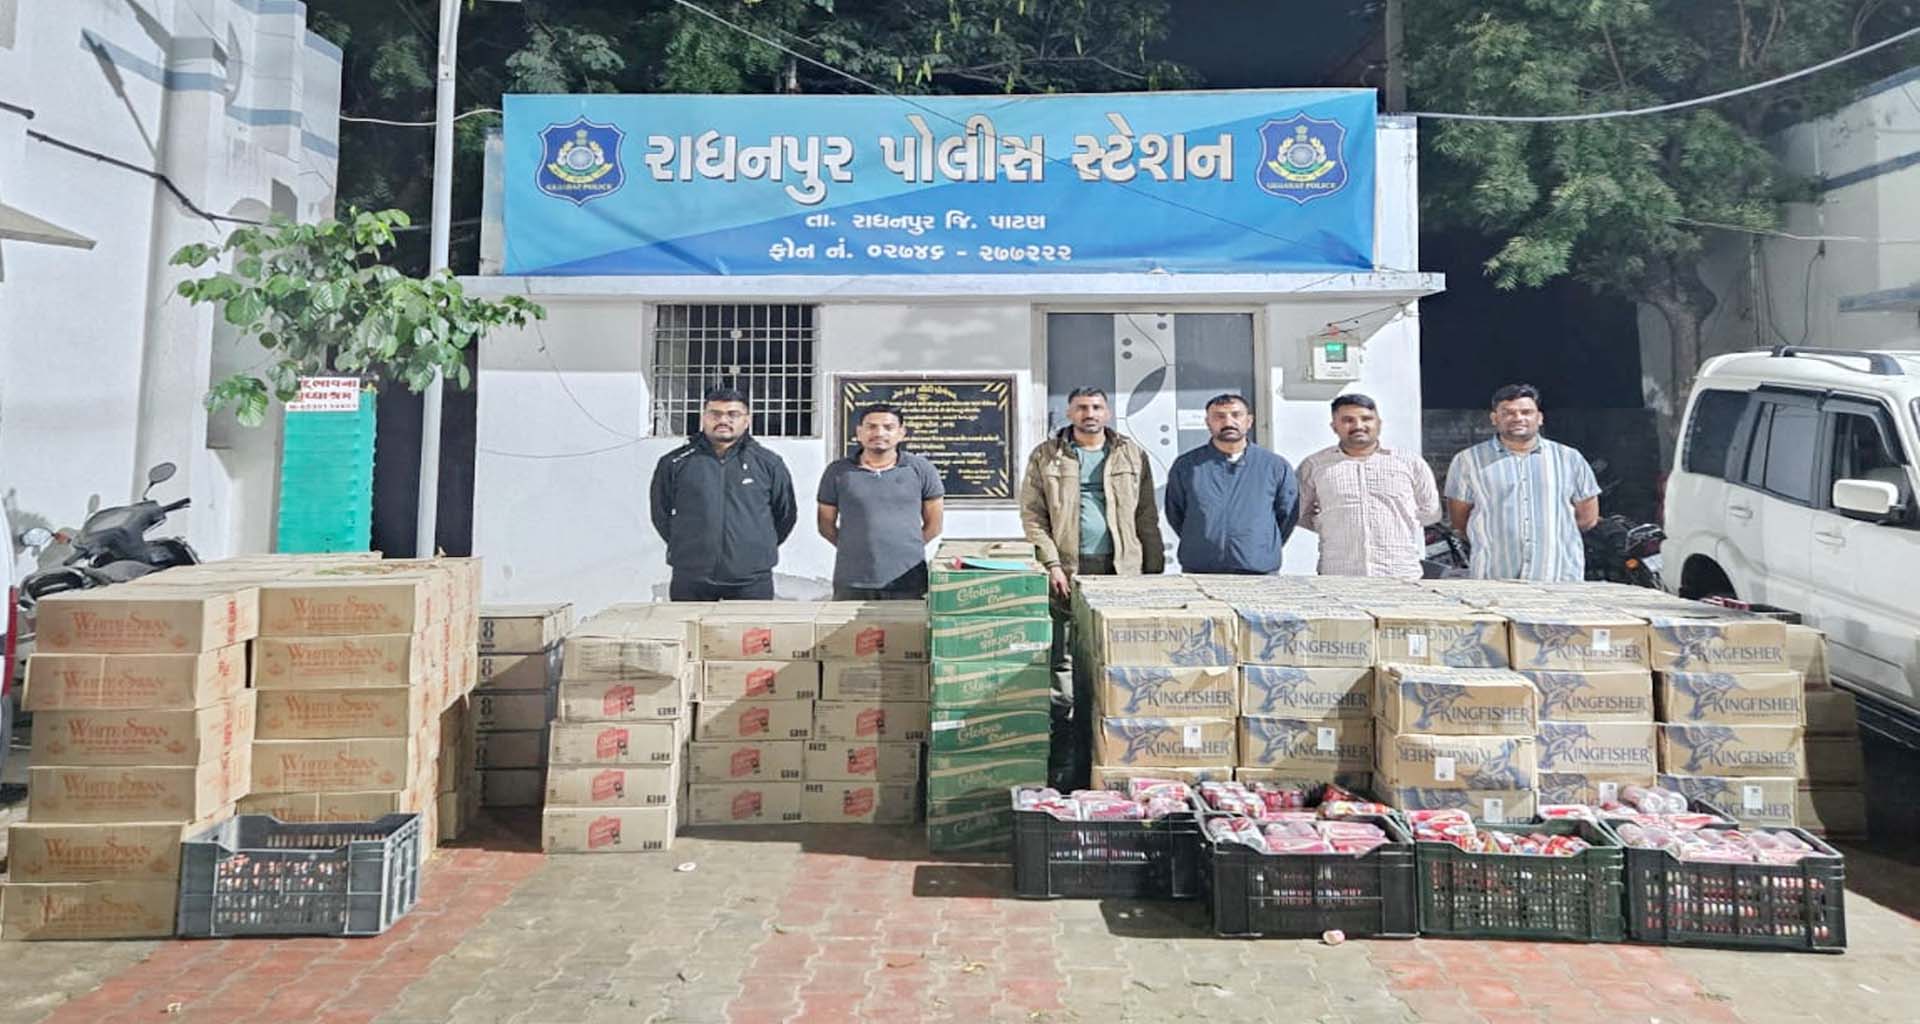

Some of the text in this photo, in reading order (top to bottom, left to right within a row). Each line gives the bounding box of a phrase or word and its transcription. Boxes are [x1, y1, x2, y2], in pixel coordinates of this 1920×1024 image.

[644, 113, 1236, 205] રાધનપુર પોલીસ સ્ટેશન
[805, 210, 1046, 235] તા. રાધનપુર જિ. પાટણ
[769, 237, 816, 262] ફોન
[825, 238, 853, 260] નં.
[978, 245, 1072, 262] ૨૭૭૨૨૨
[1282, 639, 1369, 656] KINGFISHER
[1699, 645, 1785, 663] KINGFISHER
[1147, 688, 1234, 706] KINGFISHER
[1282, 688, 1369, 707] KINGFISHER
[1561, 695, 1648, 714] KINGFISHER
[1439, 705, 1530, 724] KINGFISHER
[1563, 745, 1652, 763] KINGFISHER
[1709, 750, 1799, 767] KINGFISHER
